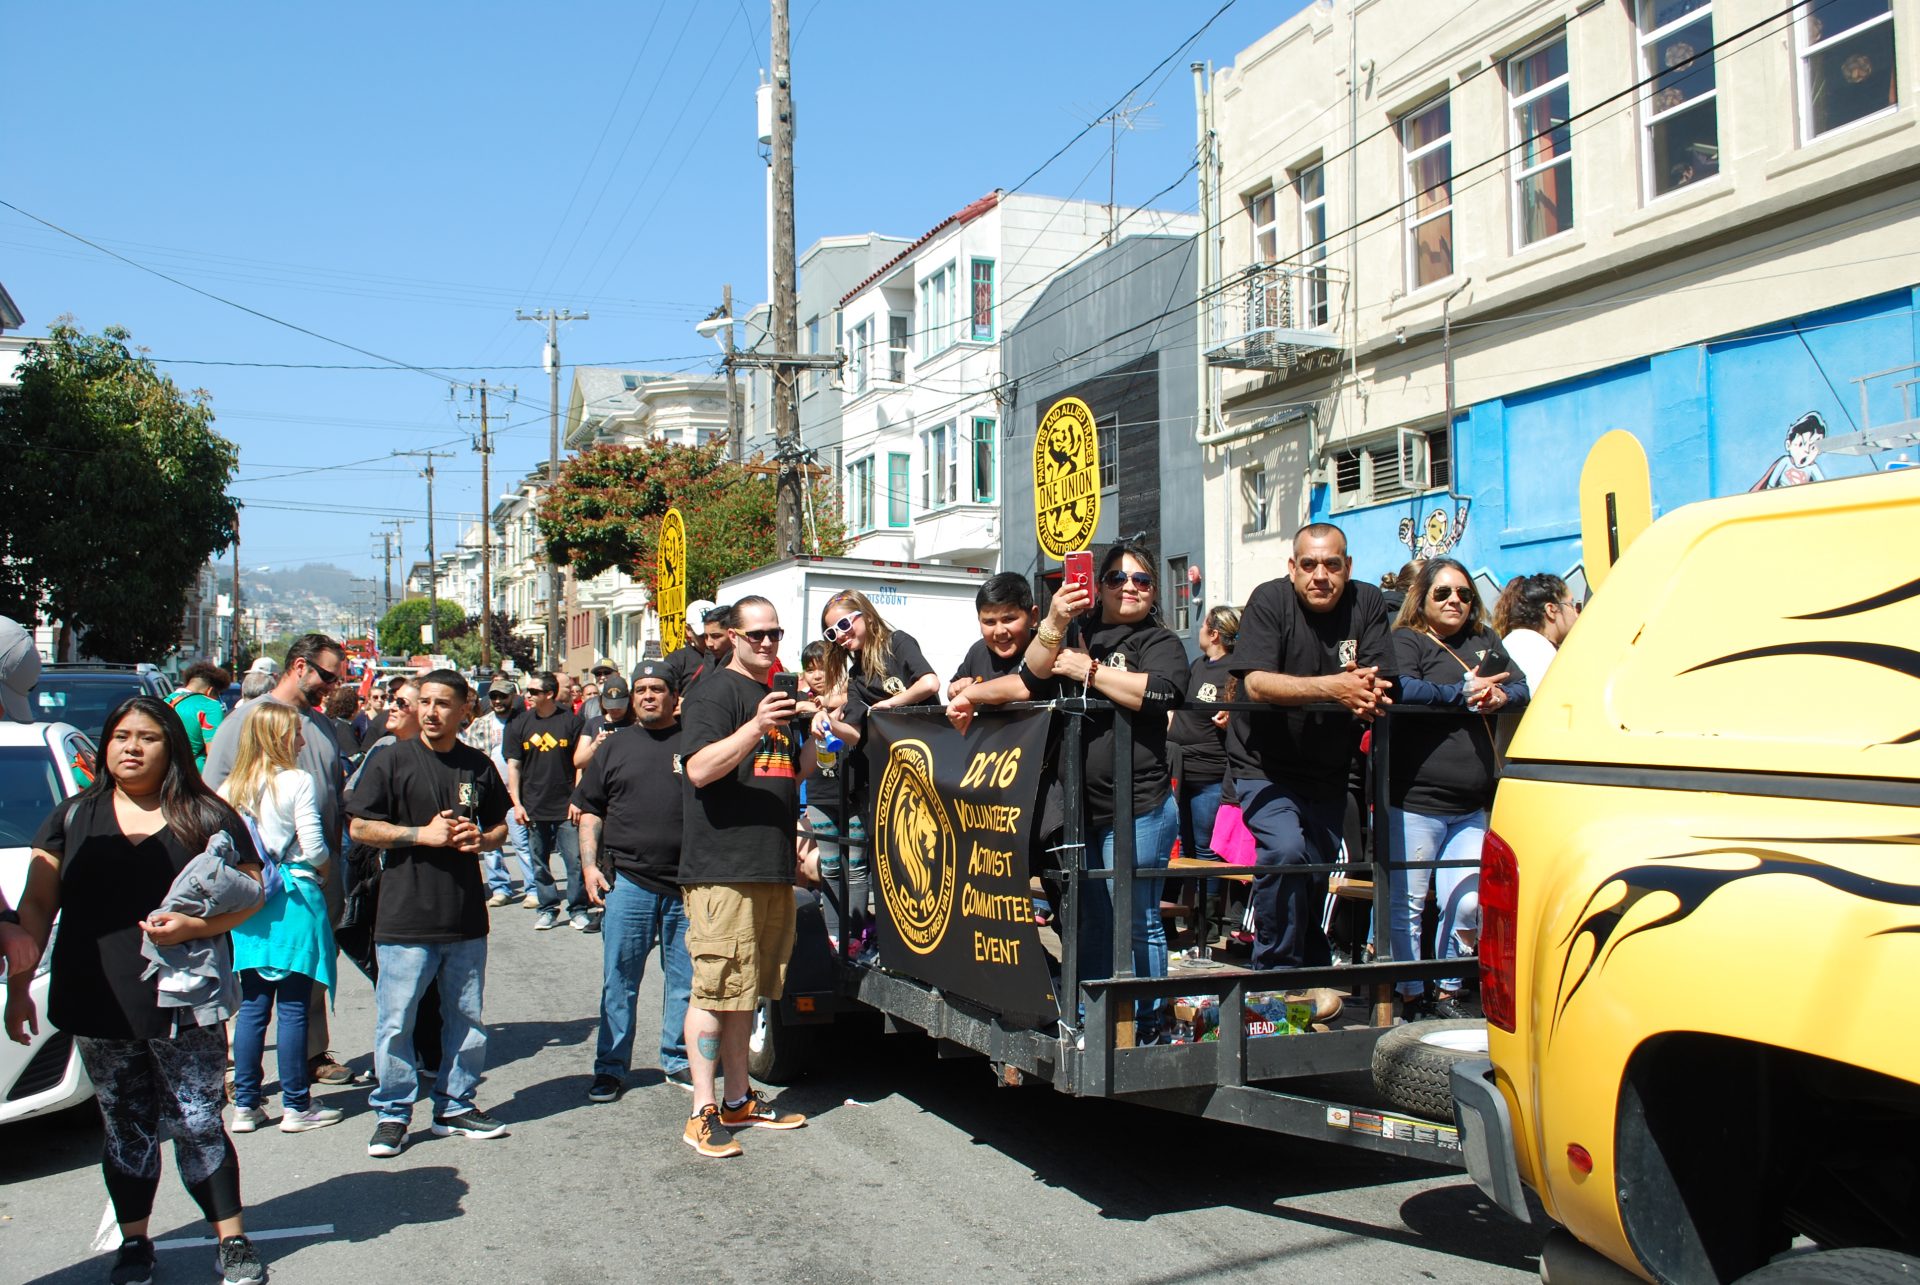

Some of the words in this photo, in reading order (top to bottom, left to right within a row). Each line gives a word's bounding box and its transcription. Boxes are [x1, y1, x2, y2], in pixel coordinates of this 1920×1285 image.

[1037, 429, 1048, 484] PAINTERS
[1045, 409, 1061, 430] AND
[1061, 404, 1086, 423] ALLIED
[1082, 419, 1094, 464] TRADES
[1040, 482, 1058, 510] ONE
[1061, 471, 1092, 502] UNION
[1038, 514, 1083, 554] INTERNATIONAL
[1080, 496, 1095, 536] UNION
[954, 798, 1021, 834] VOLUNTEER
[968, 840, 1013, 878] ACTIVIST
[879, 854, 892, 891] HIGH
[940, 864, 953, 912] VALUE
[962, 882, 1034, 923] COMMITTEE
[974, 929, 1020, 965] EVENT
